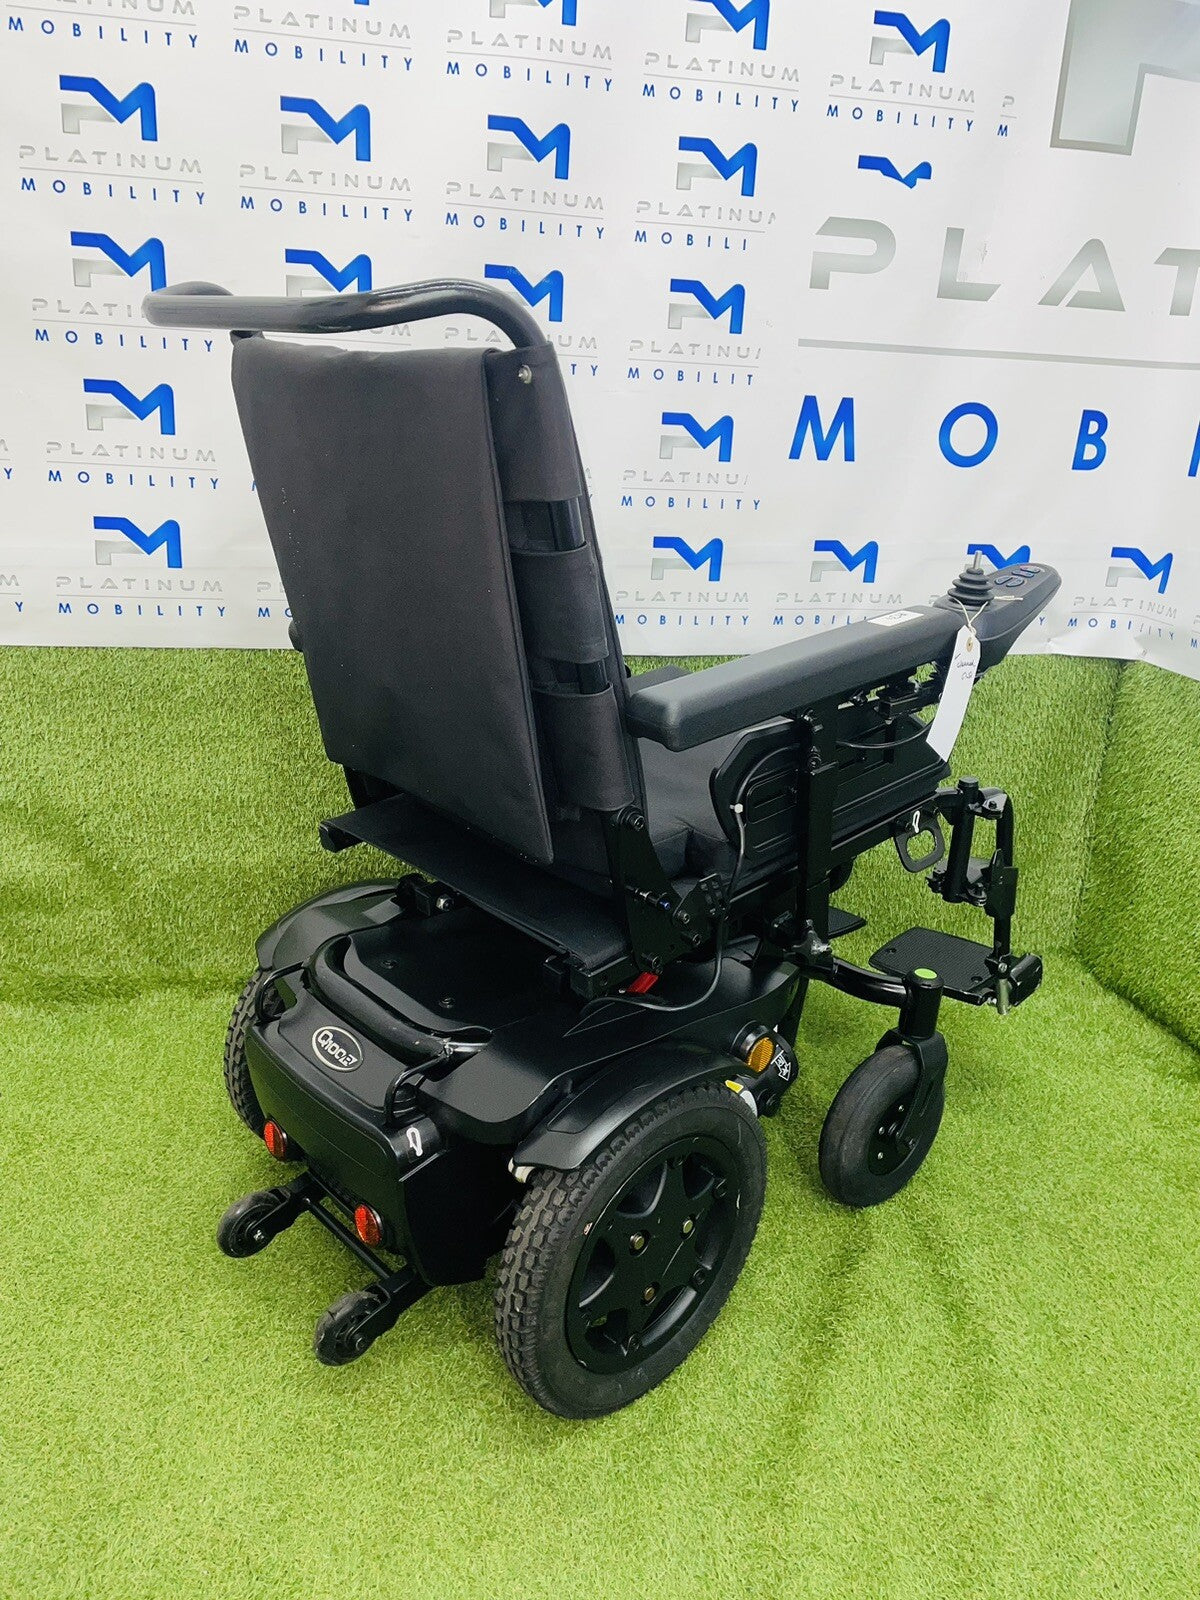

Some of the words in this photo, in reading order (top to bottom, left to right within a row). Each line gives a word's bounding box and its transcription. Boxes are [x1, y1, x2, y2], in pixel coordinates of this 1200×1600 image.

[8, 16, 197, 48] MOBILITY
[233, 5, 411, 40] PLATINUM
[234, 39, 412, 71] MOBILITY
[446, 29, 613, 61] PLATINUM
[446, 61, 613, 92] MOBILITY
[644, 52, 800, 83] PLATINUM
[642, 83, 799, 112] MOBILITY
[829, 73, 976, 104] PLATINUM
[826, 105, 974, 132] MOBILITY
[19, 145, 202, 174] PLATINUM
[20, 177, 205, 205] MOBILITY
[239, 163, 412, 192] PLATINUM
[240, 195, 412, 222] MOBILITY
[445, 181, 604, 211] PLATINUM
[445, 212, 604, 240] MOBILITY
[32, 298, 144, 320] PLATI
[34, 328, 214, 353] MOBILITY
[46, 441, 216, 463] PLATINUM
[48, 469, 219, 490] MOBILITY
[620, 495, 761, 511] MOBILITY
[56, 576, 224, 593] PLATINUM
[615, 590, 749, 603] PLATINUM
[58, 602, 226, 618] MOBILITY
[776, 592, 903, 605] PLATINUM
[1073, 596, 1178, 619] PLATINUM
[615, 614, 749, 626] MOBILITY
